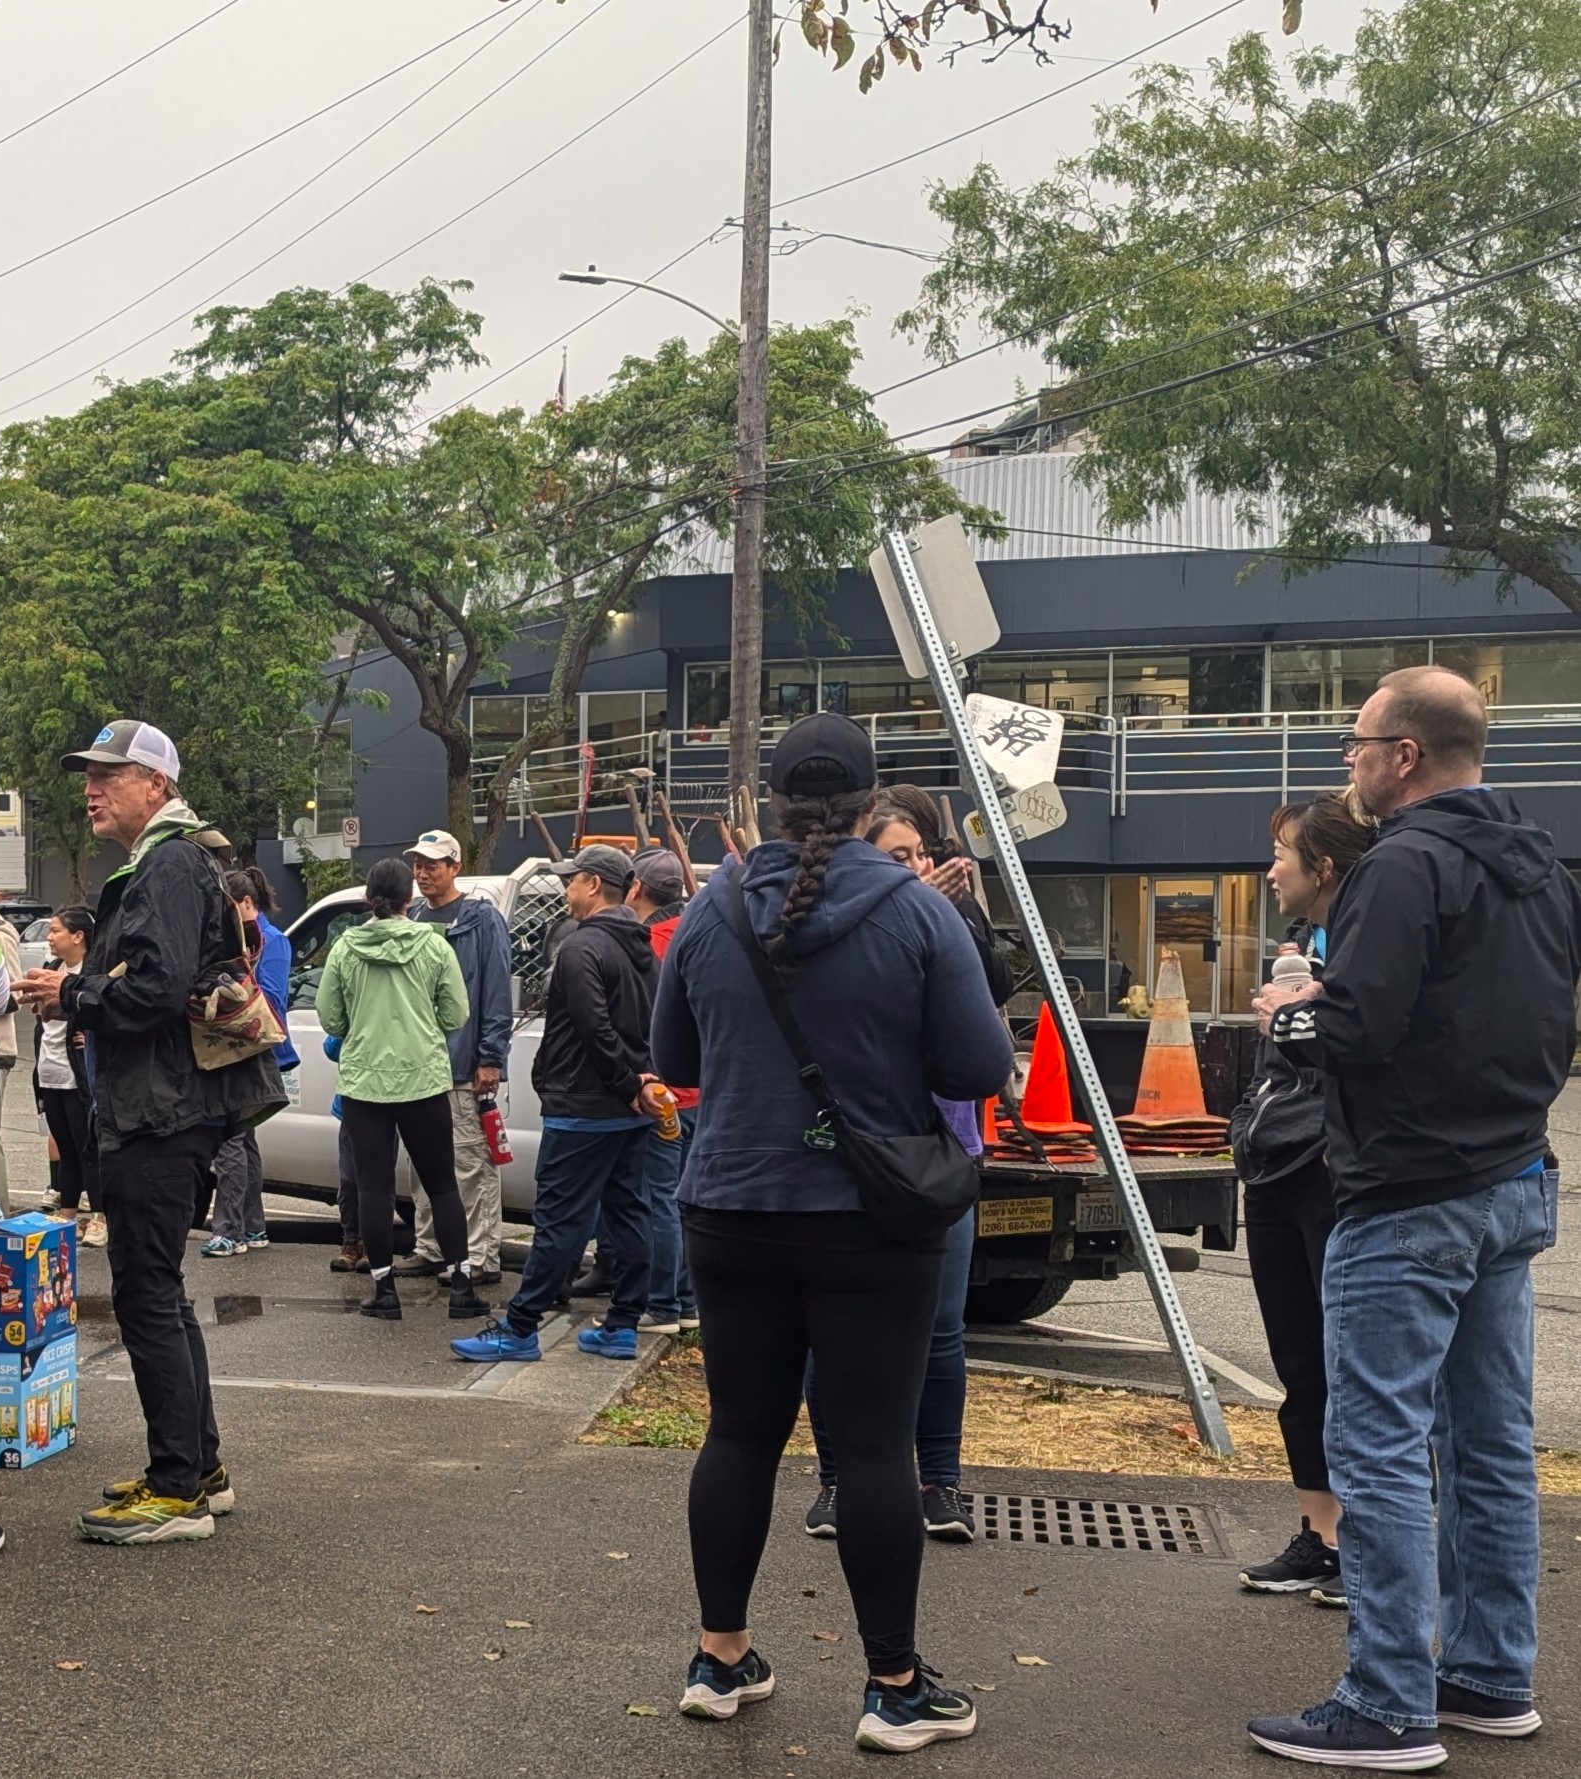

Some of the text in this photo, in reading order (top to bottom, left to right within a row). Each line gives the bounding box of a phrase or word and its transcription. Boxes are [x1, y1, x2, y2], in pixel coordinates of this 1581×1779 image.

[981, 1219, 1052, 1234] (206) 684-7087
[9, 1324, 23, 1337] 54
[4, 1452, 19, 1463] 36
